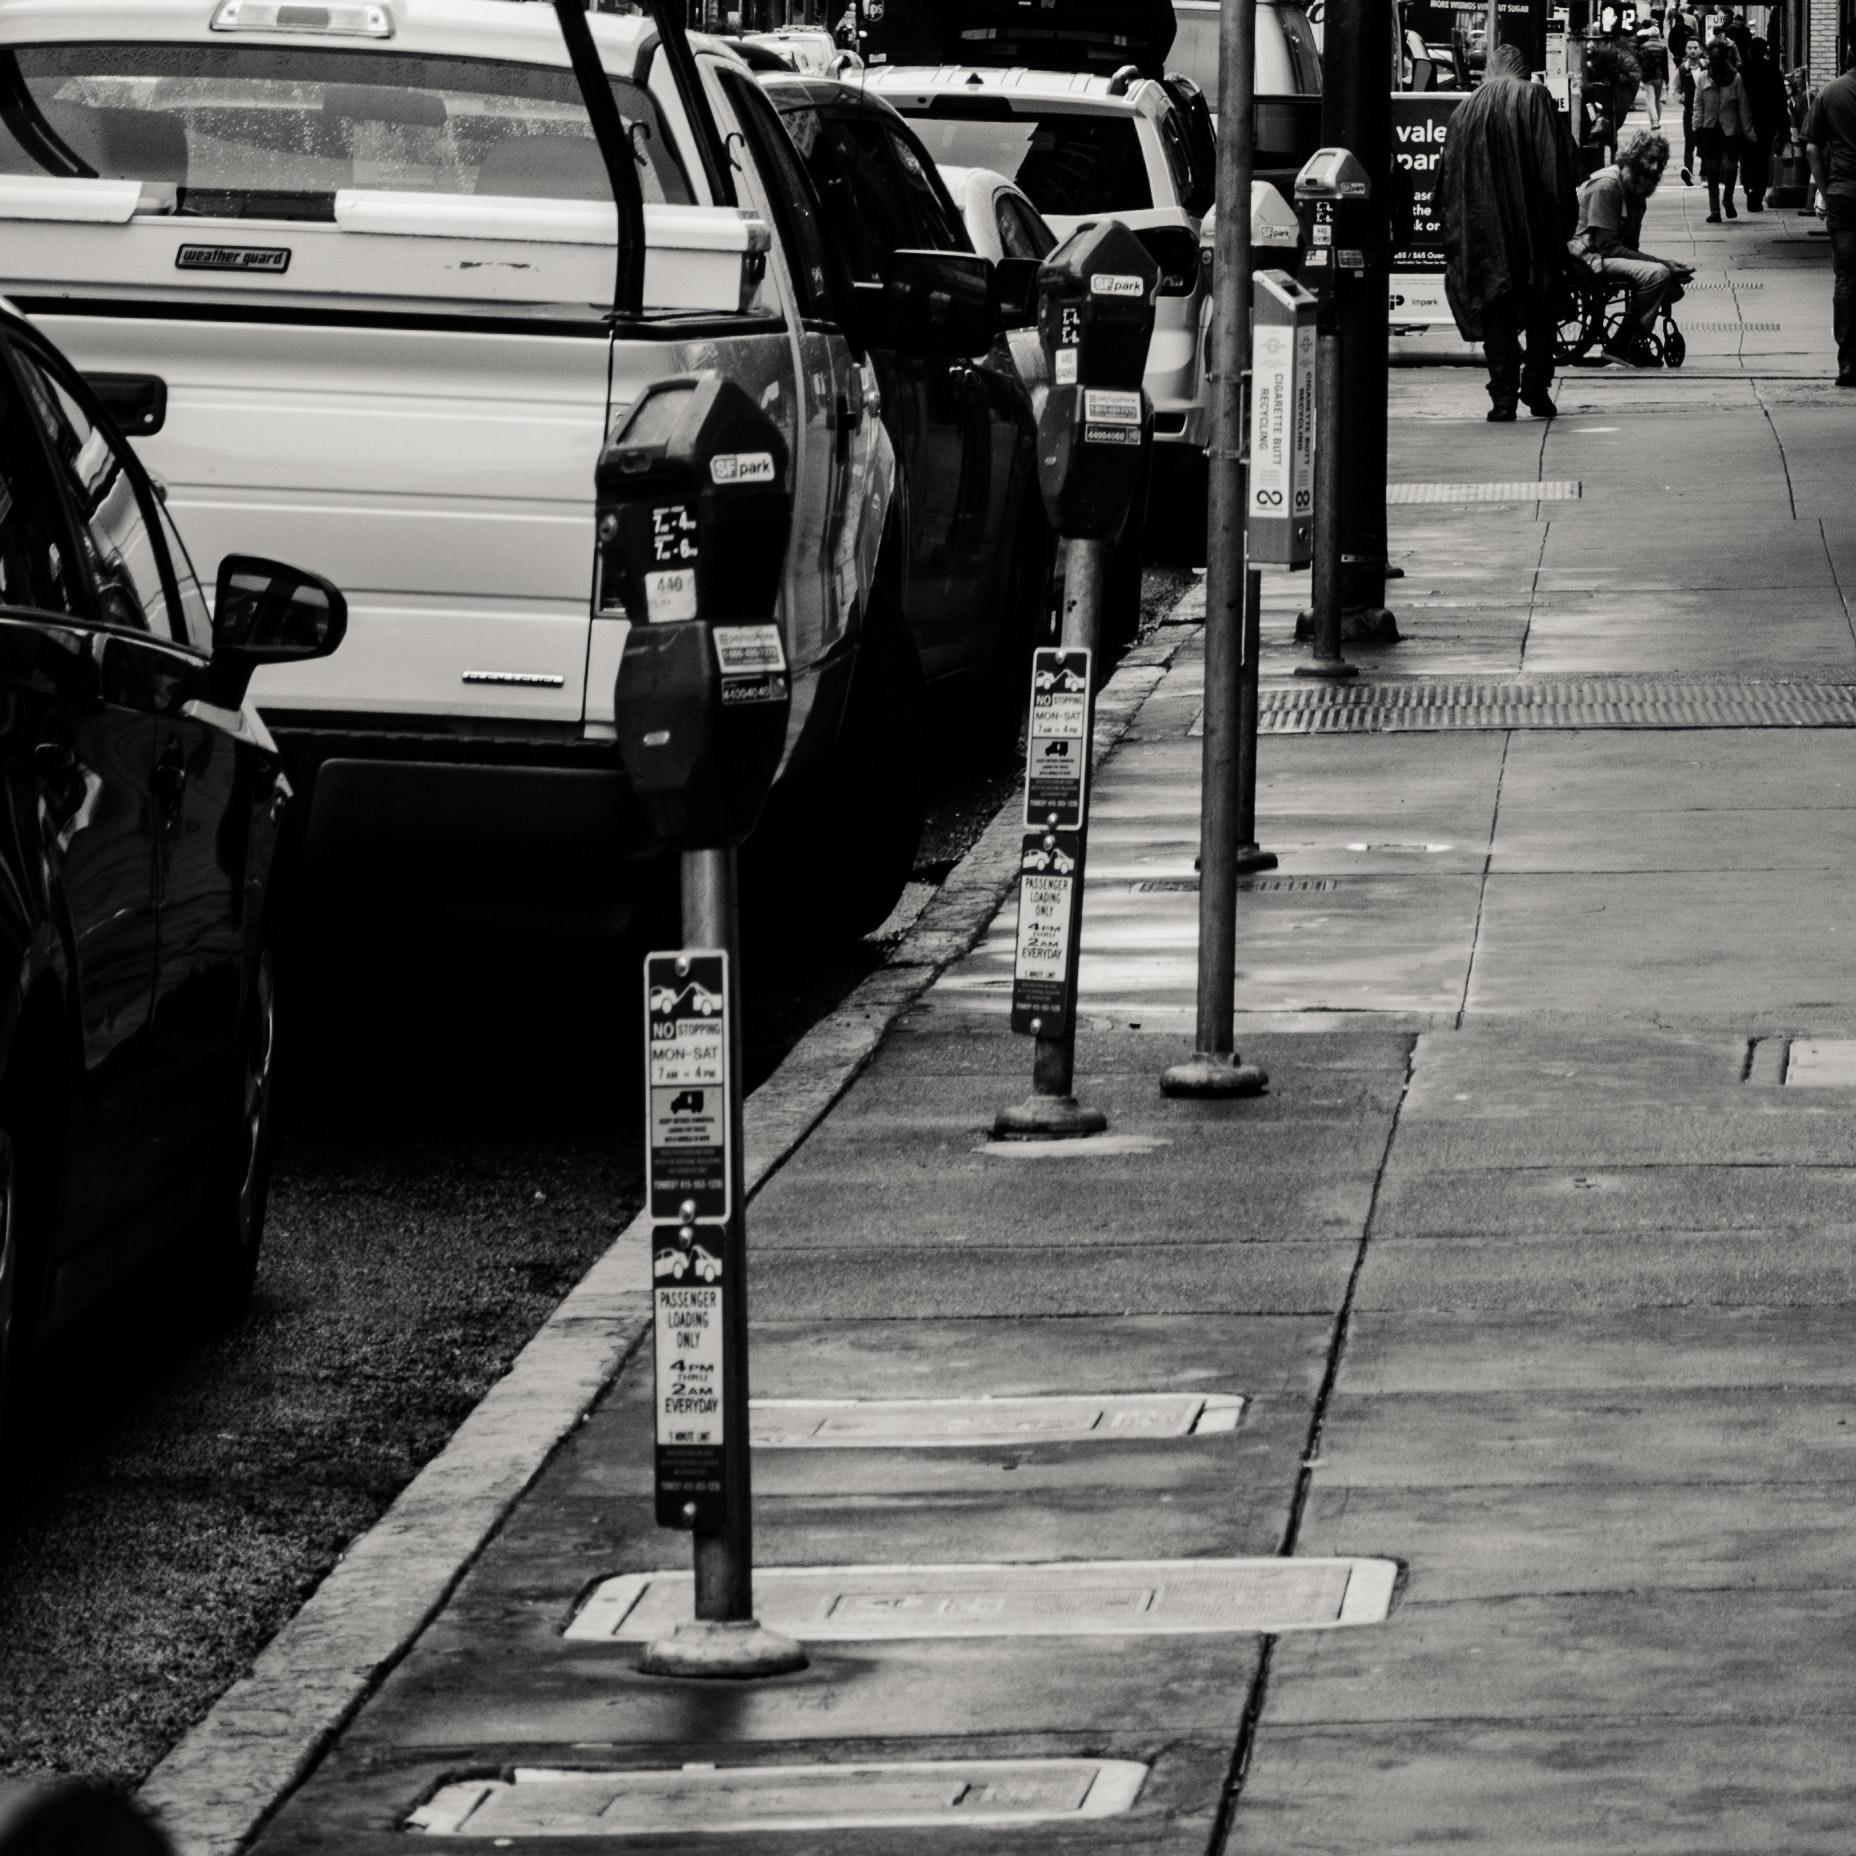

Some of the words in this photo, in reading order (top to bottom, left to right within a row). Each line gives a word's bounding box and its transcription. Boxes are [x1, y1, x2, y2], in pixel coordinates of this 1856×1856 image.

[1272, 372, 1284, 439] CIGARETTE
[1258, 387, 1270, 451] RECYCLING
[1271, 438, 1283, 466] BUTT
[652, 1021, 676, 1039] NO
[677, 1021, 721, 1037] STOPPING
[651, 1046, 719, 1062] MON-SAT
[659, 1291, 717, 1308] PASSENGER
[667, 1311, 710, 1330] LOADING
[676, 1331, 702, 1349] ONLY
[664, 1397, 718, 1414] EVERYDAY
